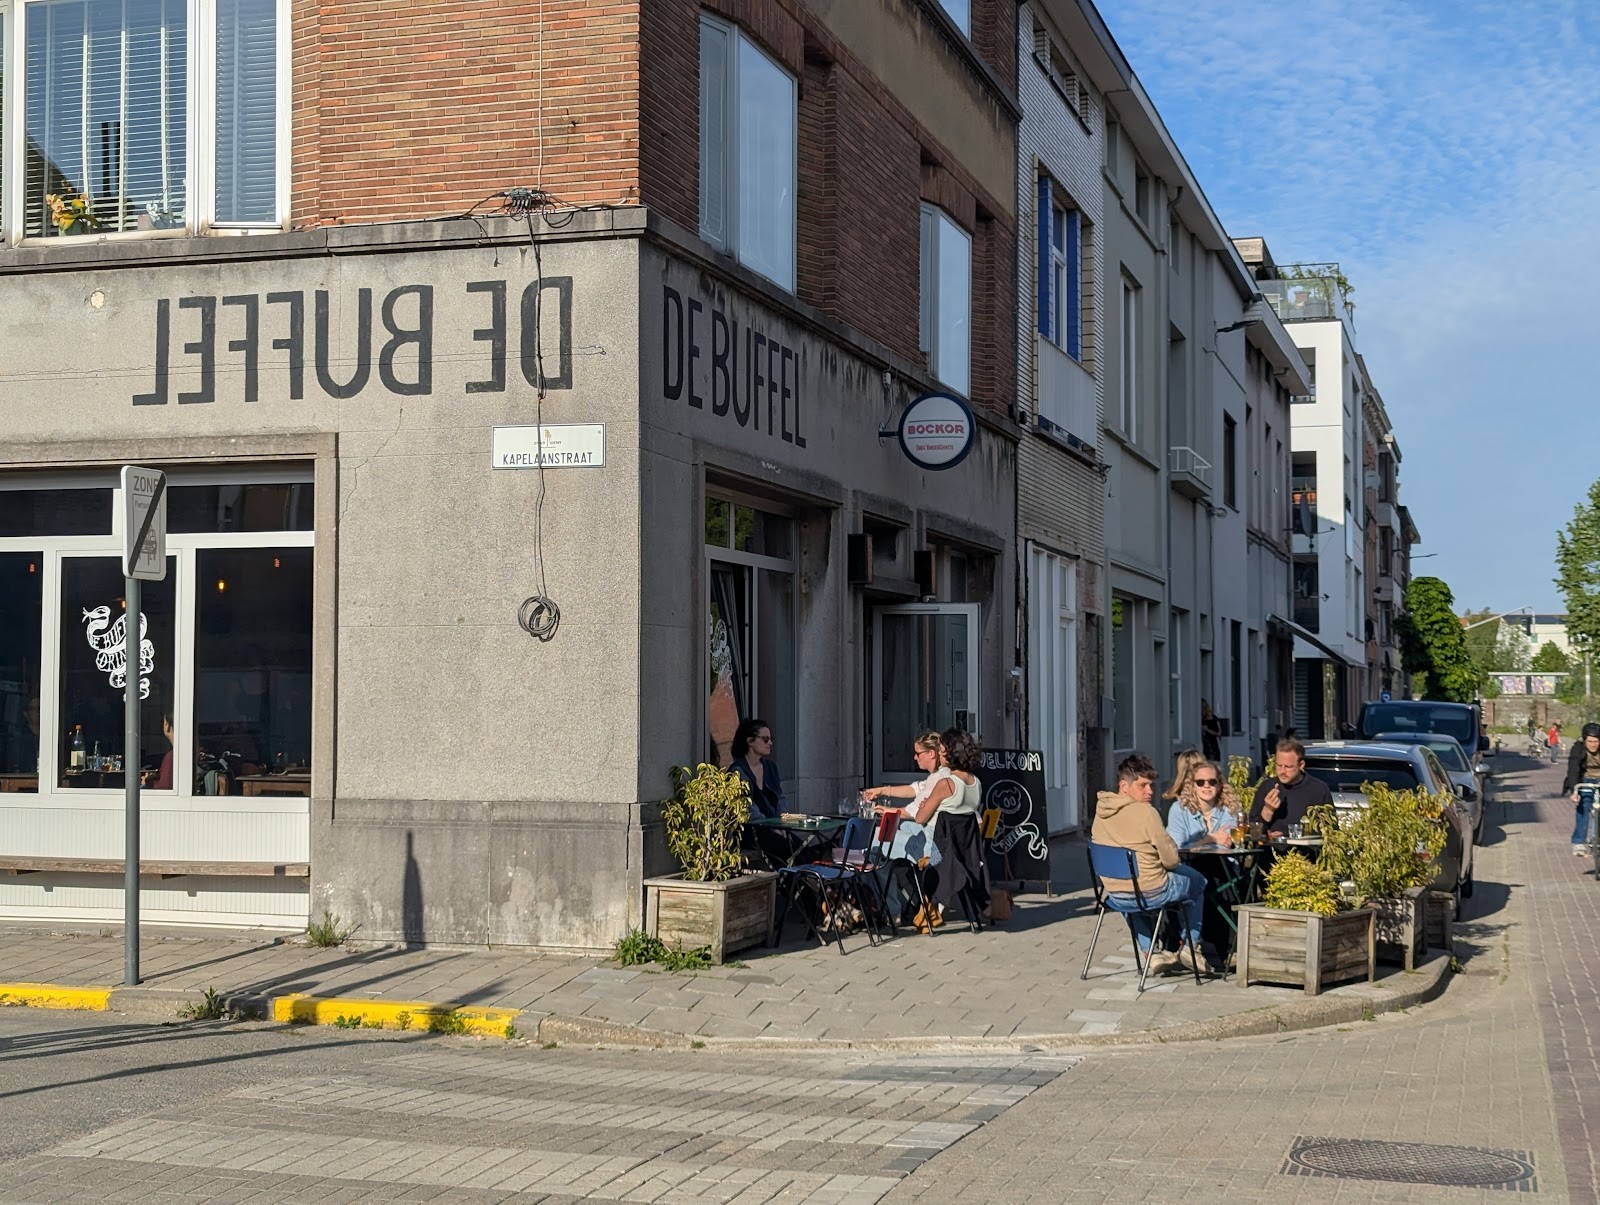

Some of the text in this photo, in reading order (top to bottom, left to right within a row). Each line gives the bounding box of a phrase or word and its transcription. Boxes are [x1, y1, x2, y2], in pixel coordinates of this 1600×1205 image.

[663, 285, 807, 449] DE BUFFEL
[907, 424, 965, 435] BOCKOR
[503, 452, 593, 465] KAPELAANSTRAAT
